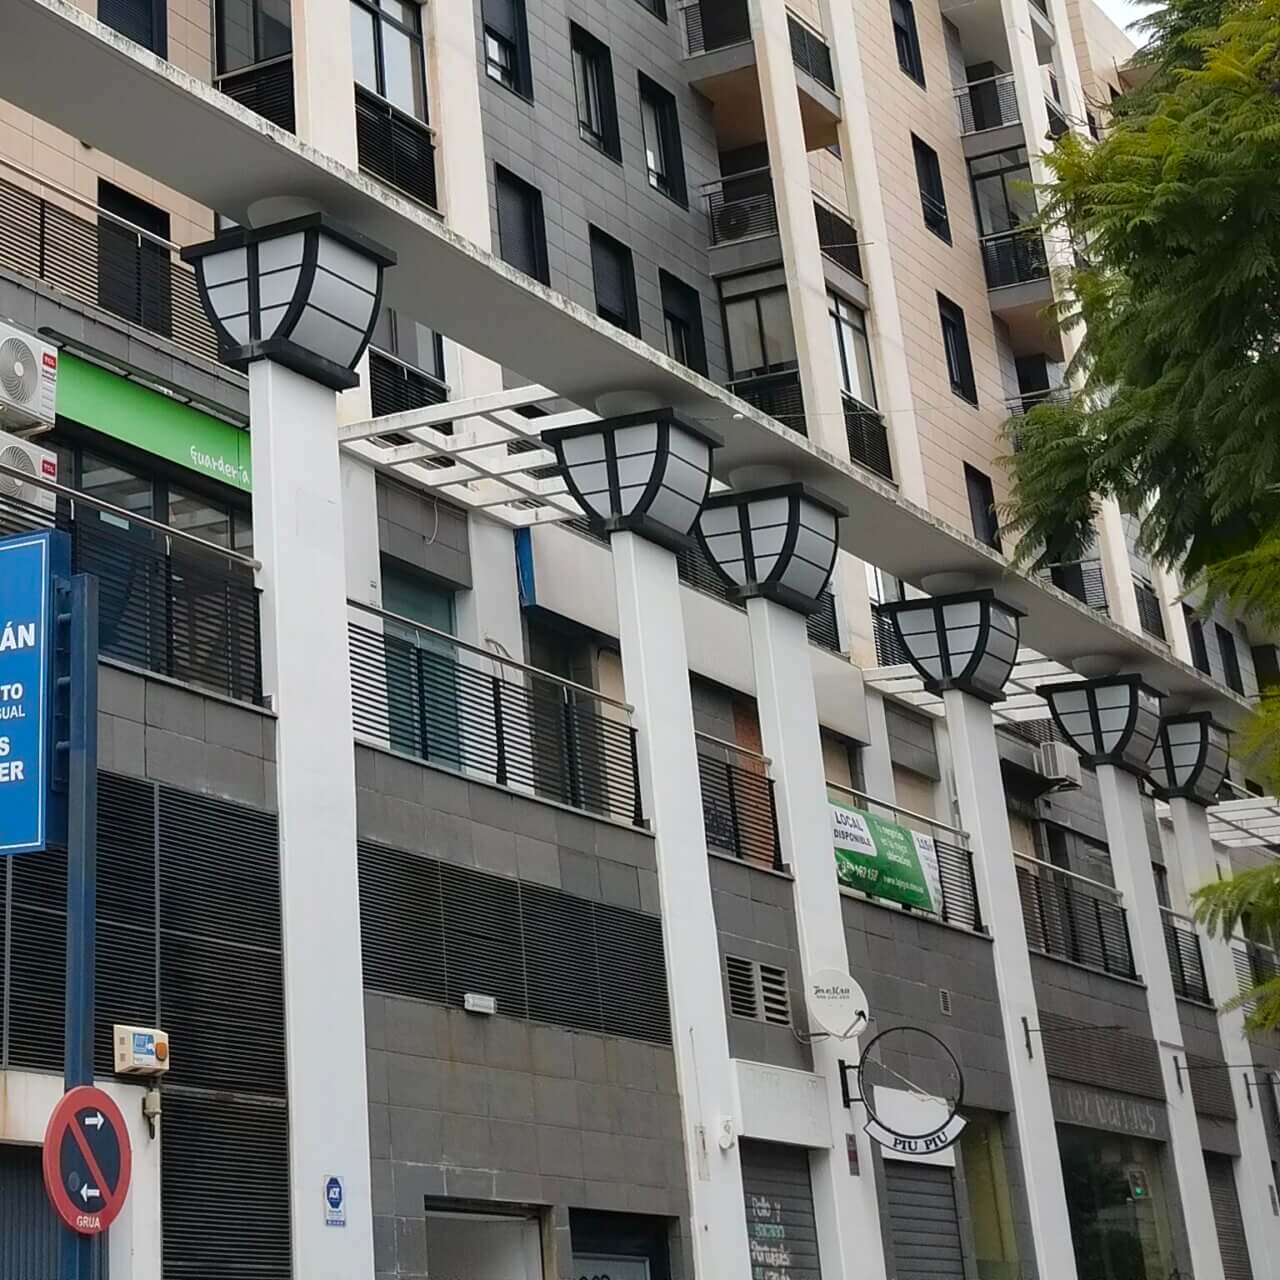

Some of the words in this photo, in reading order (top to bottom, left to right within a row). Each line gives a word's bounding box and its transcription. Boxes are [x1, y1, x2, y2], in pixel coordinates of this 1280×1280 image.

[834, 810, 864, 832] LOCAL
[893, 1137, 918, 1151] PIU
[924, 1131, 948, 1150] PIU
[76, 1215, 101, 1228] GRUA
